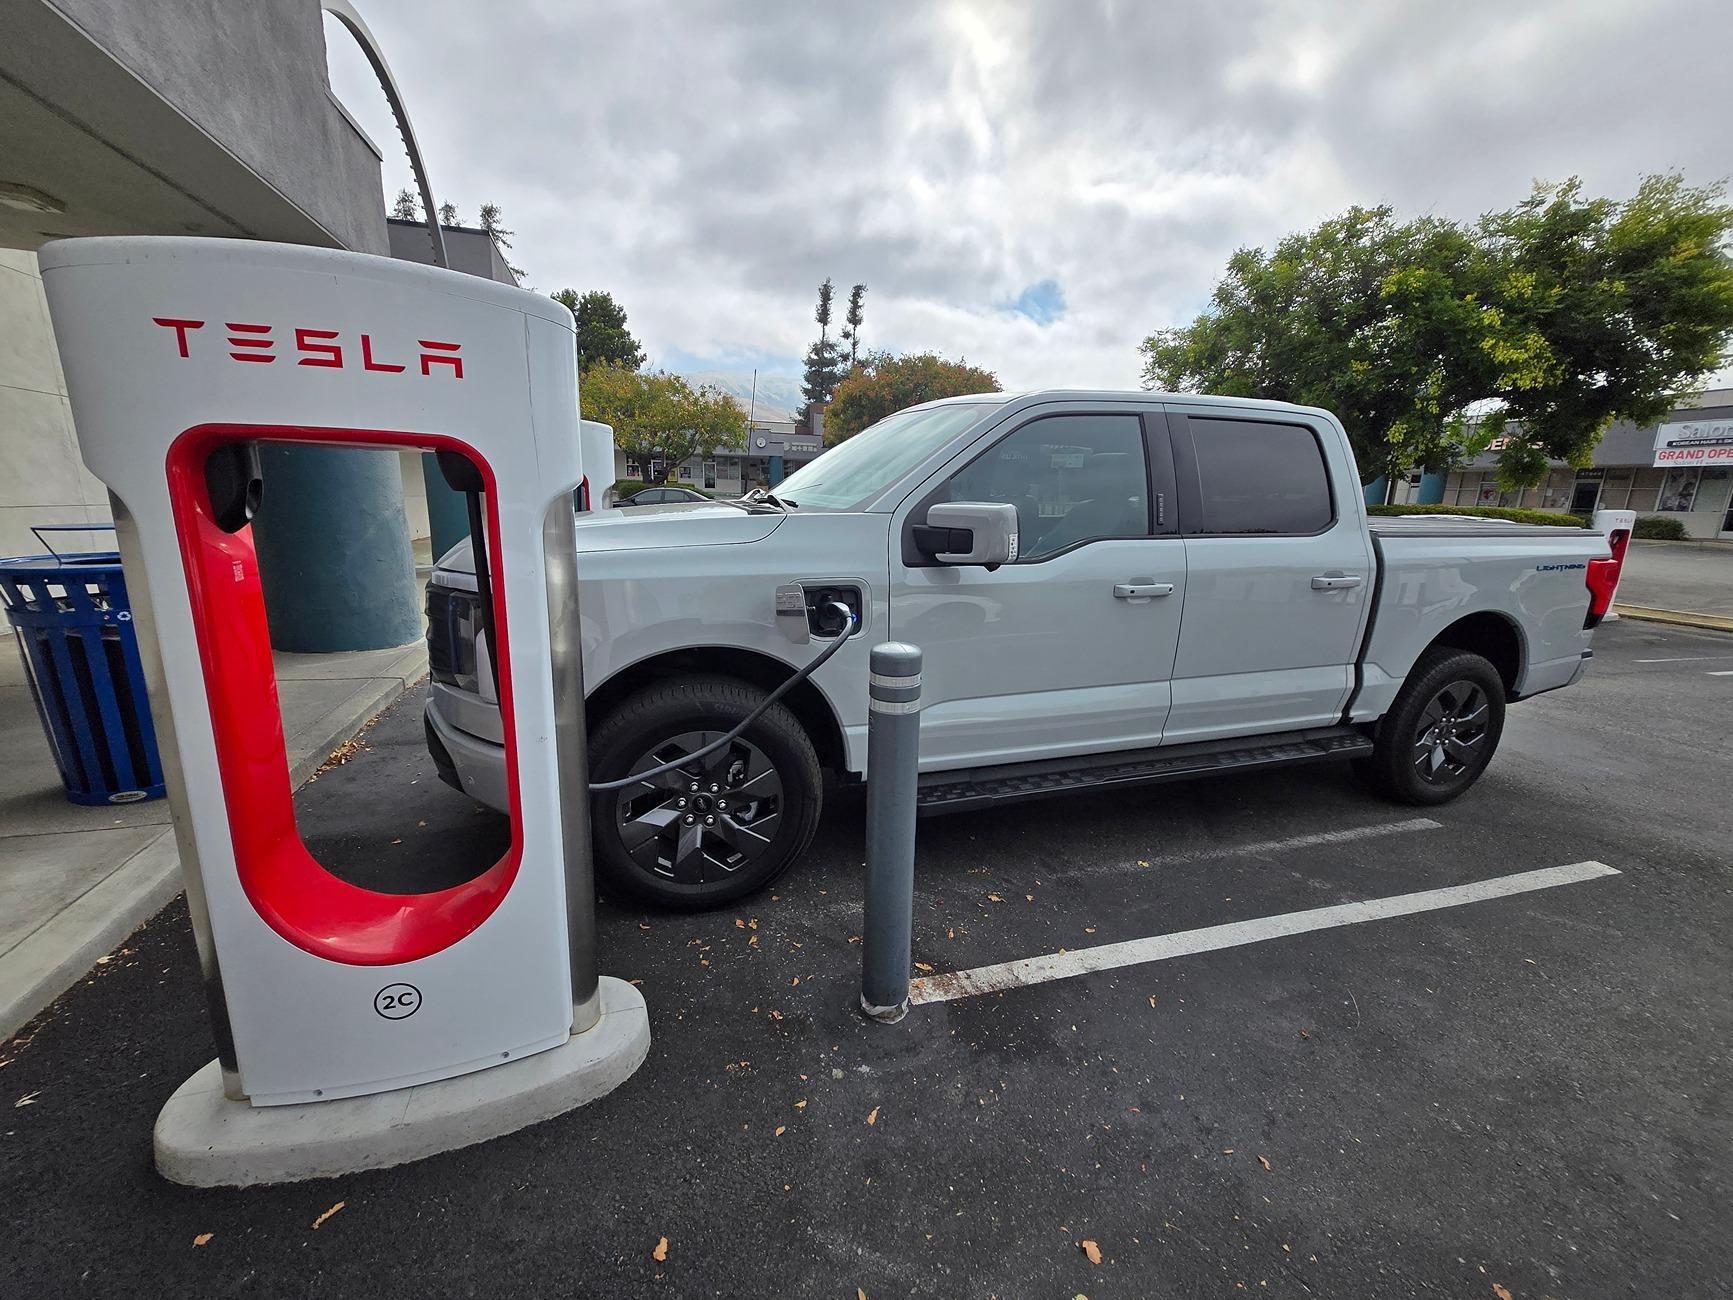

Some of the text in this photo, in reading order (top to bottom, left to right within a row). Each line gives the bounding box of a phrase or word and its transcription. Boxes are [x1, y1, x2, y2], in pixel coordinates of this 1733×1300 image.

[152, 317, 463, 380] TESLA
[1658, 449, 1705, 461] GRAND
[1536, 563, 1586, 572] LIGHTNING
[382, 992, 414, 1010] 2C
